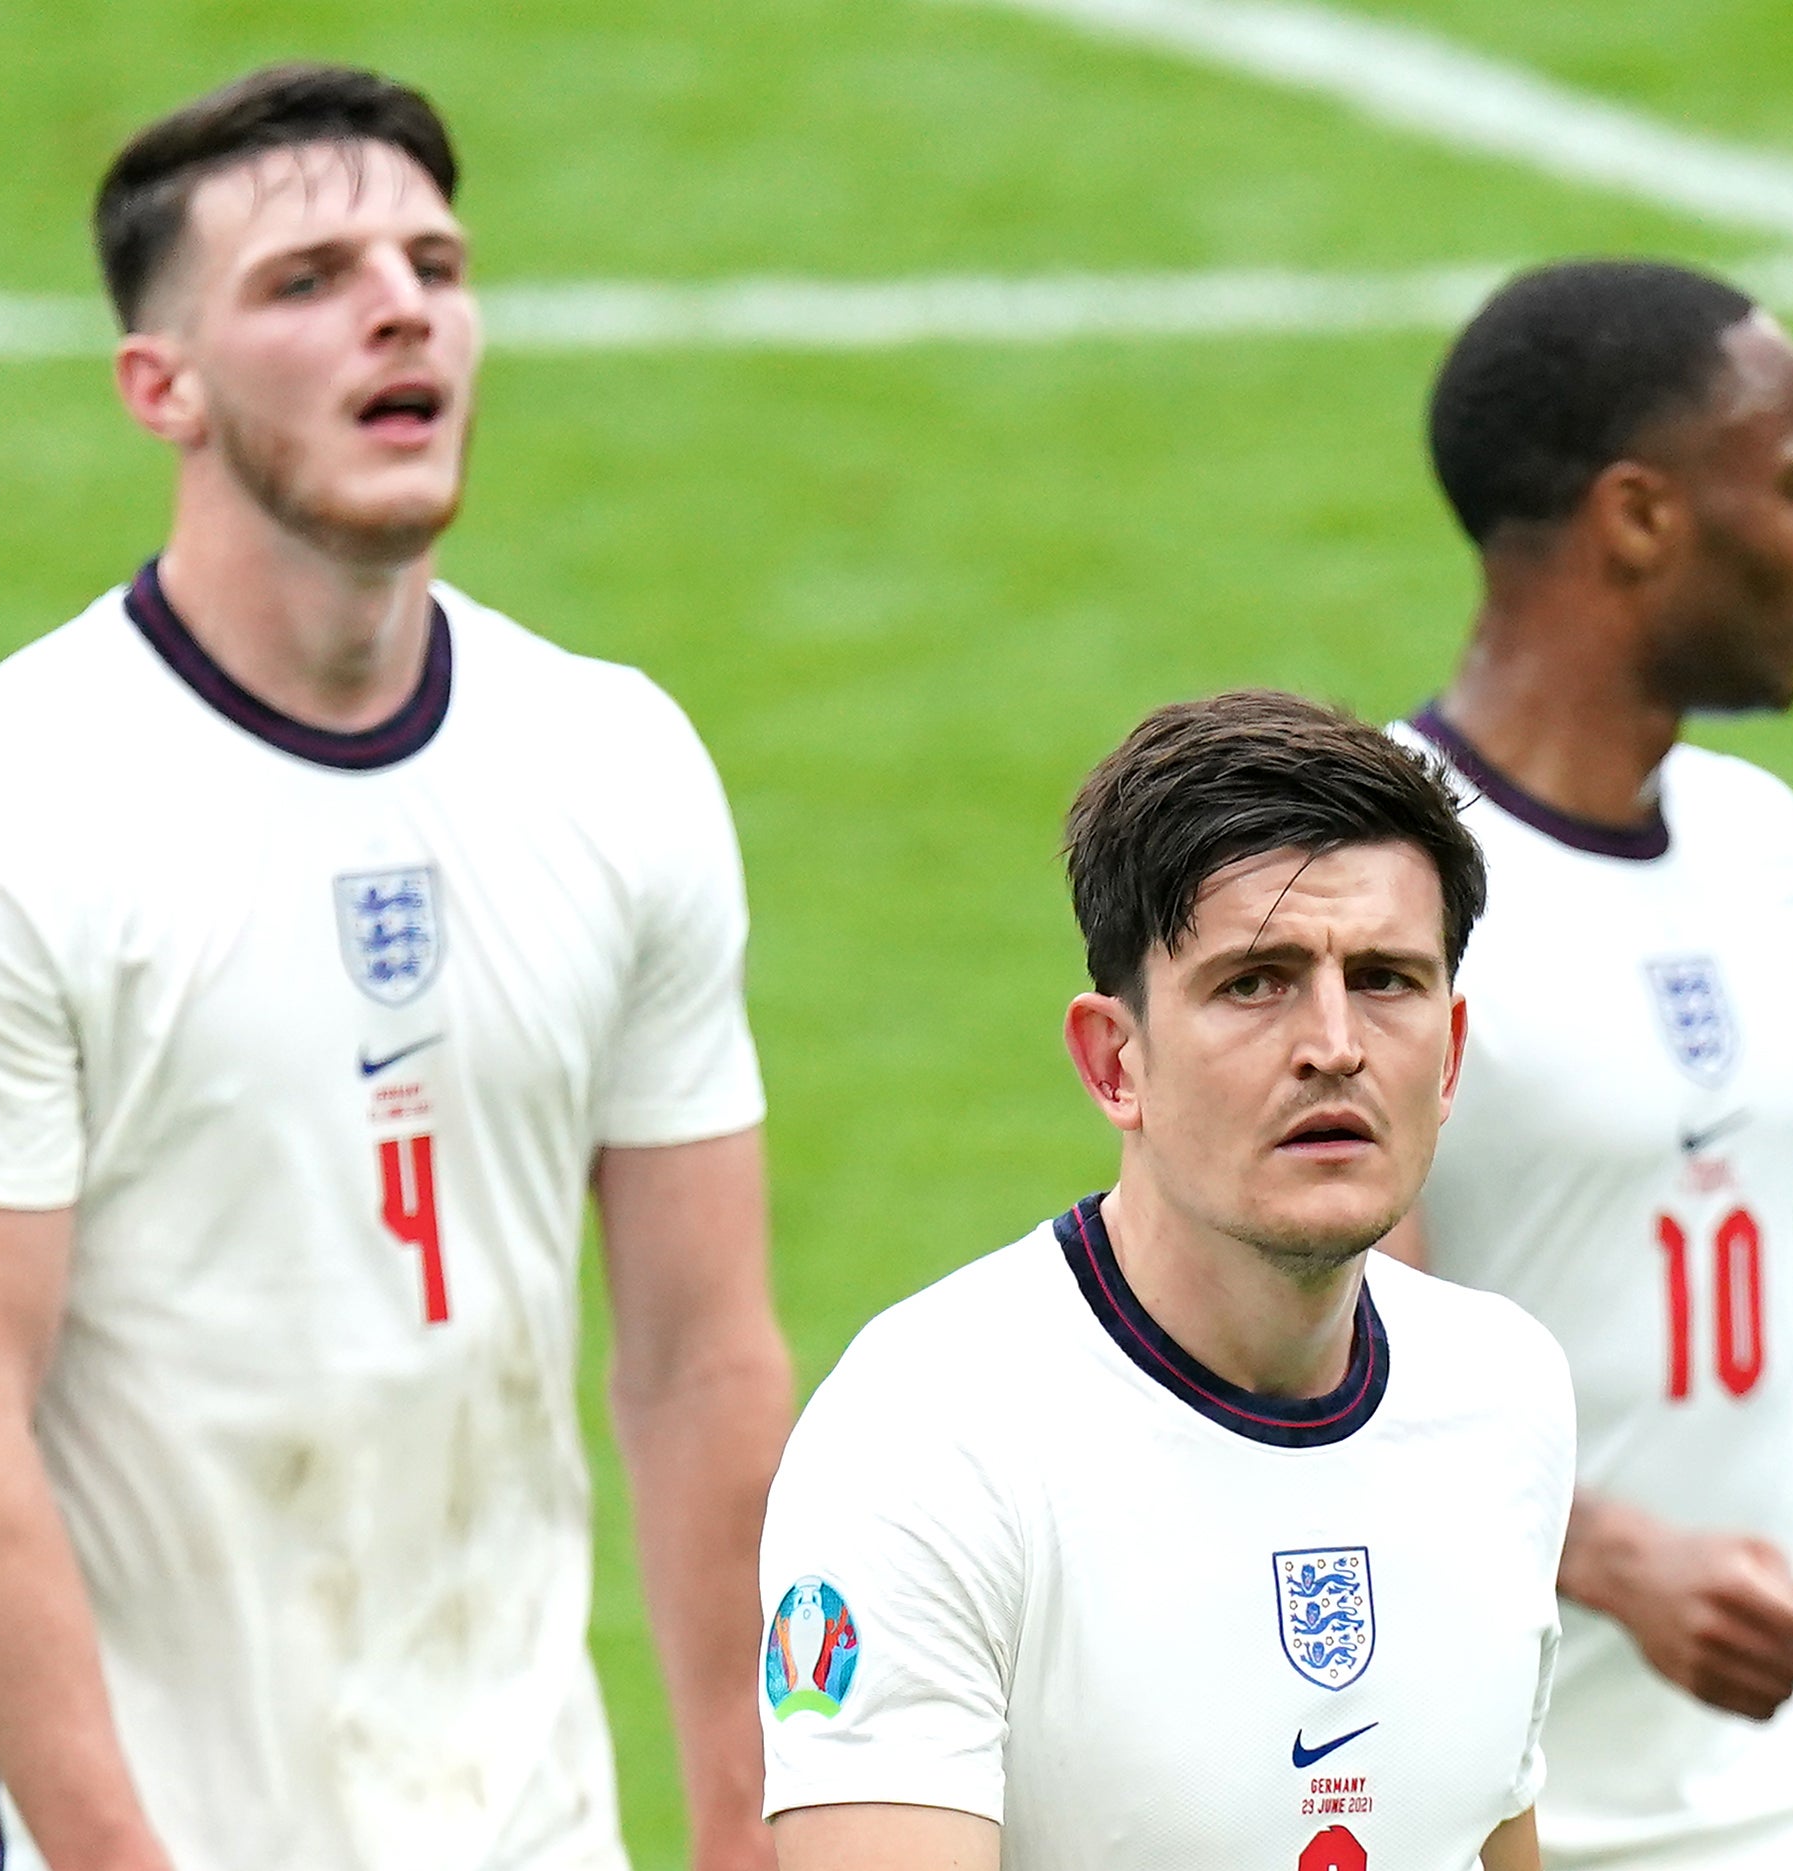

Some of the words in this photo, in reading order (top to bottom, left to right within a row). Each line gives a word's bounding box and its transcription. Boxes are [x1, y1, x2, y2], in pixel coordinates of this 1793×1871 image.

[377, 1134, 449, 1323] 4
[1656, 1210, 1764, 1399] 10
[1302, 1798, 1315, 1815] 29
[1317, 1797, 1346, 1814] JUNE
[1348, 1796, 1373, 1813] 2021
[1311, 1777, 1366, 1794] GERMANY
